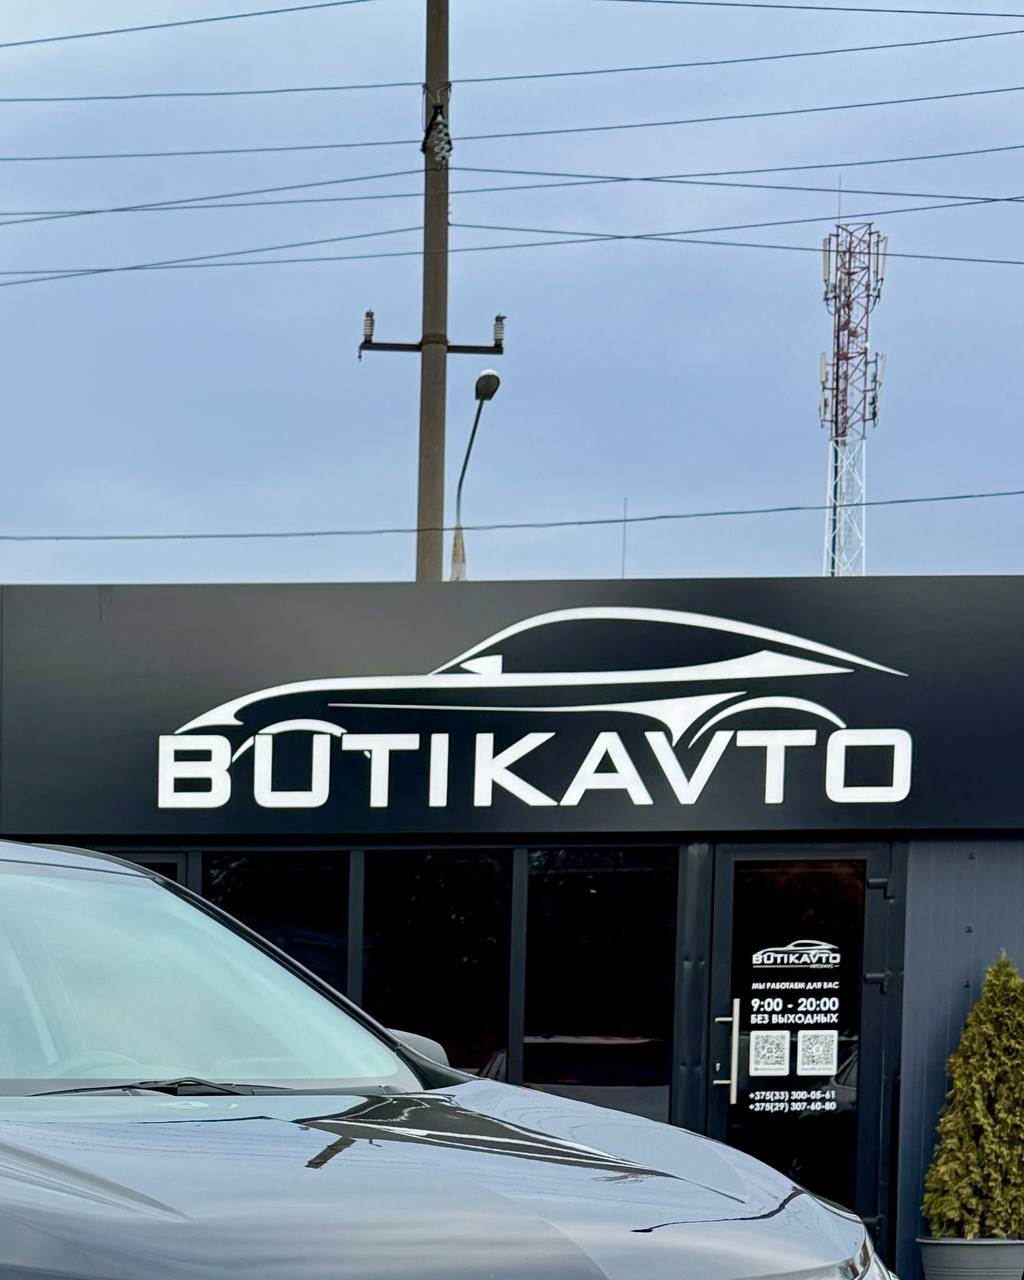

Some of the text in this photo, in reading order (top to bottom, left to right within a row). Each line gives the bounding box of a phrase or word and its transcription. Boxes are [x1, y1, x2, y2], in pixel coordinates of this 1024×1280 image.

[158, 728, 913, 809] BUTIKAVTO
[752, 953, 841, 964] BUTIKAVTO
[751, 998, 783, 1012] 9:00
[797, 997, 839, 1011] 20:00
[750, 1013, 839, 1024] БЕЗ ВЫХОДНЫХ
